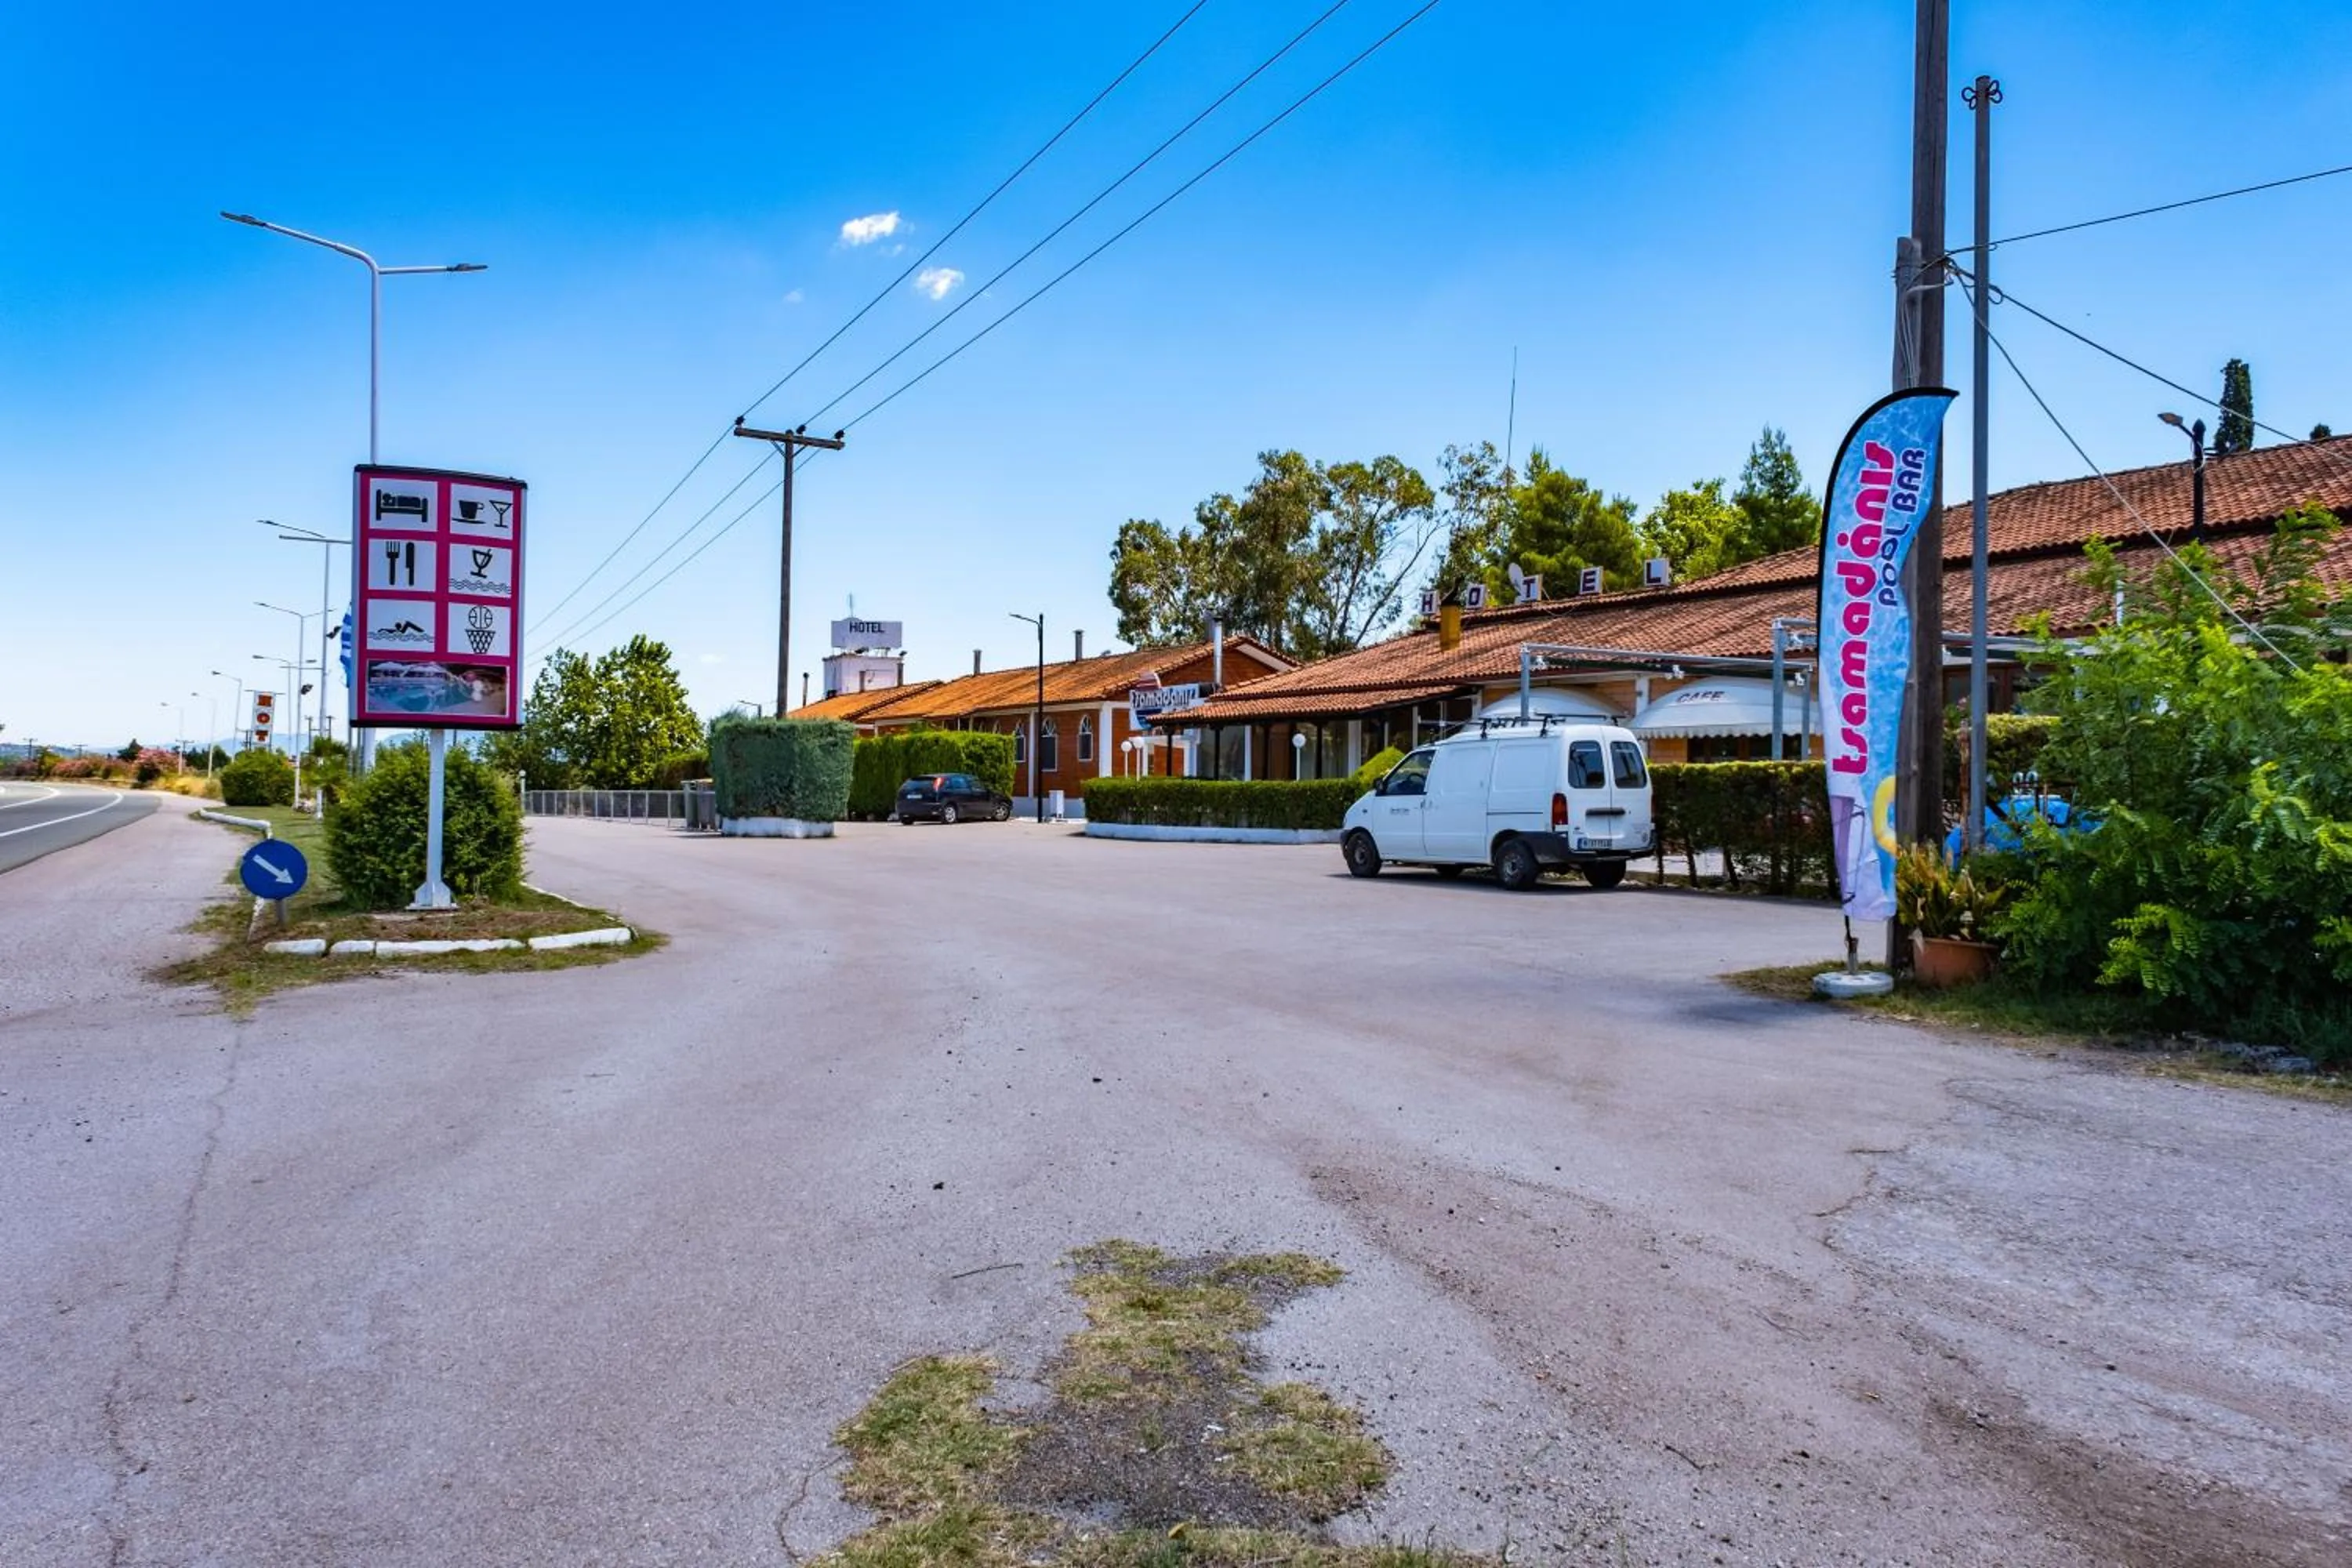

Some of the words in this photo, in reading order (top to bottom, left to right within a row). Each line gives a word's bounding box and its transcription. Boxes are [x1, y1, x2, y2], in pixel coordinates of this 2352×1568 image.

[1891, 448, 1926, 514] BAR
[1421, 562, 1661, 612] HOTEL
[1878, 523, 1909, 607] POOL
[848, 620, 885, 633] HOTEL
